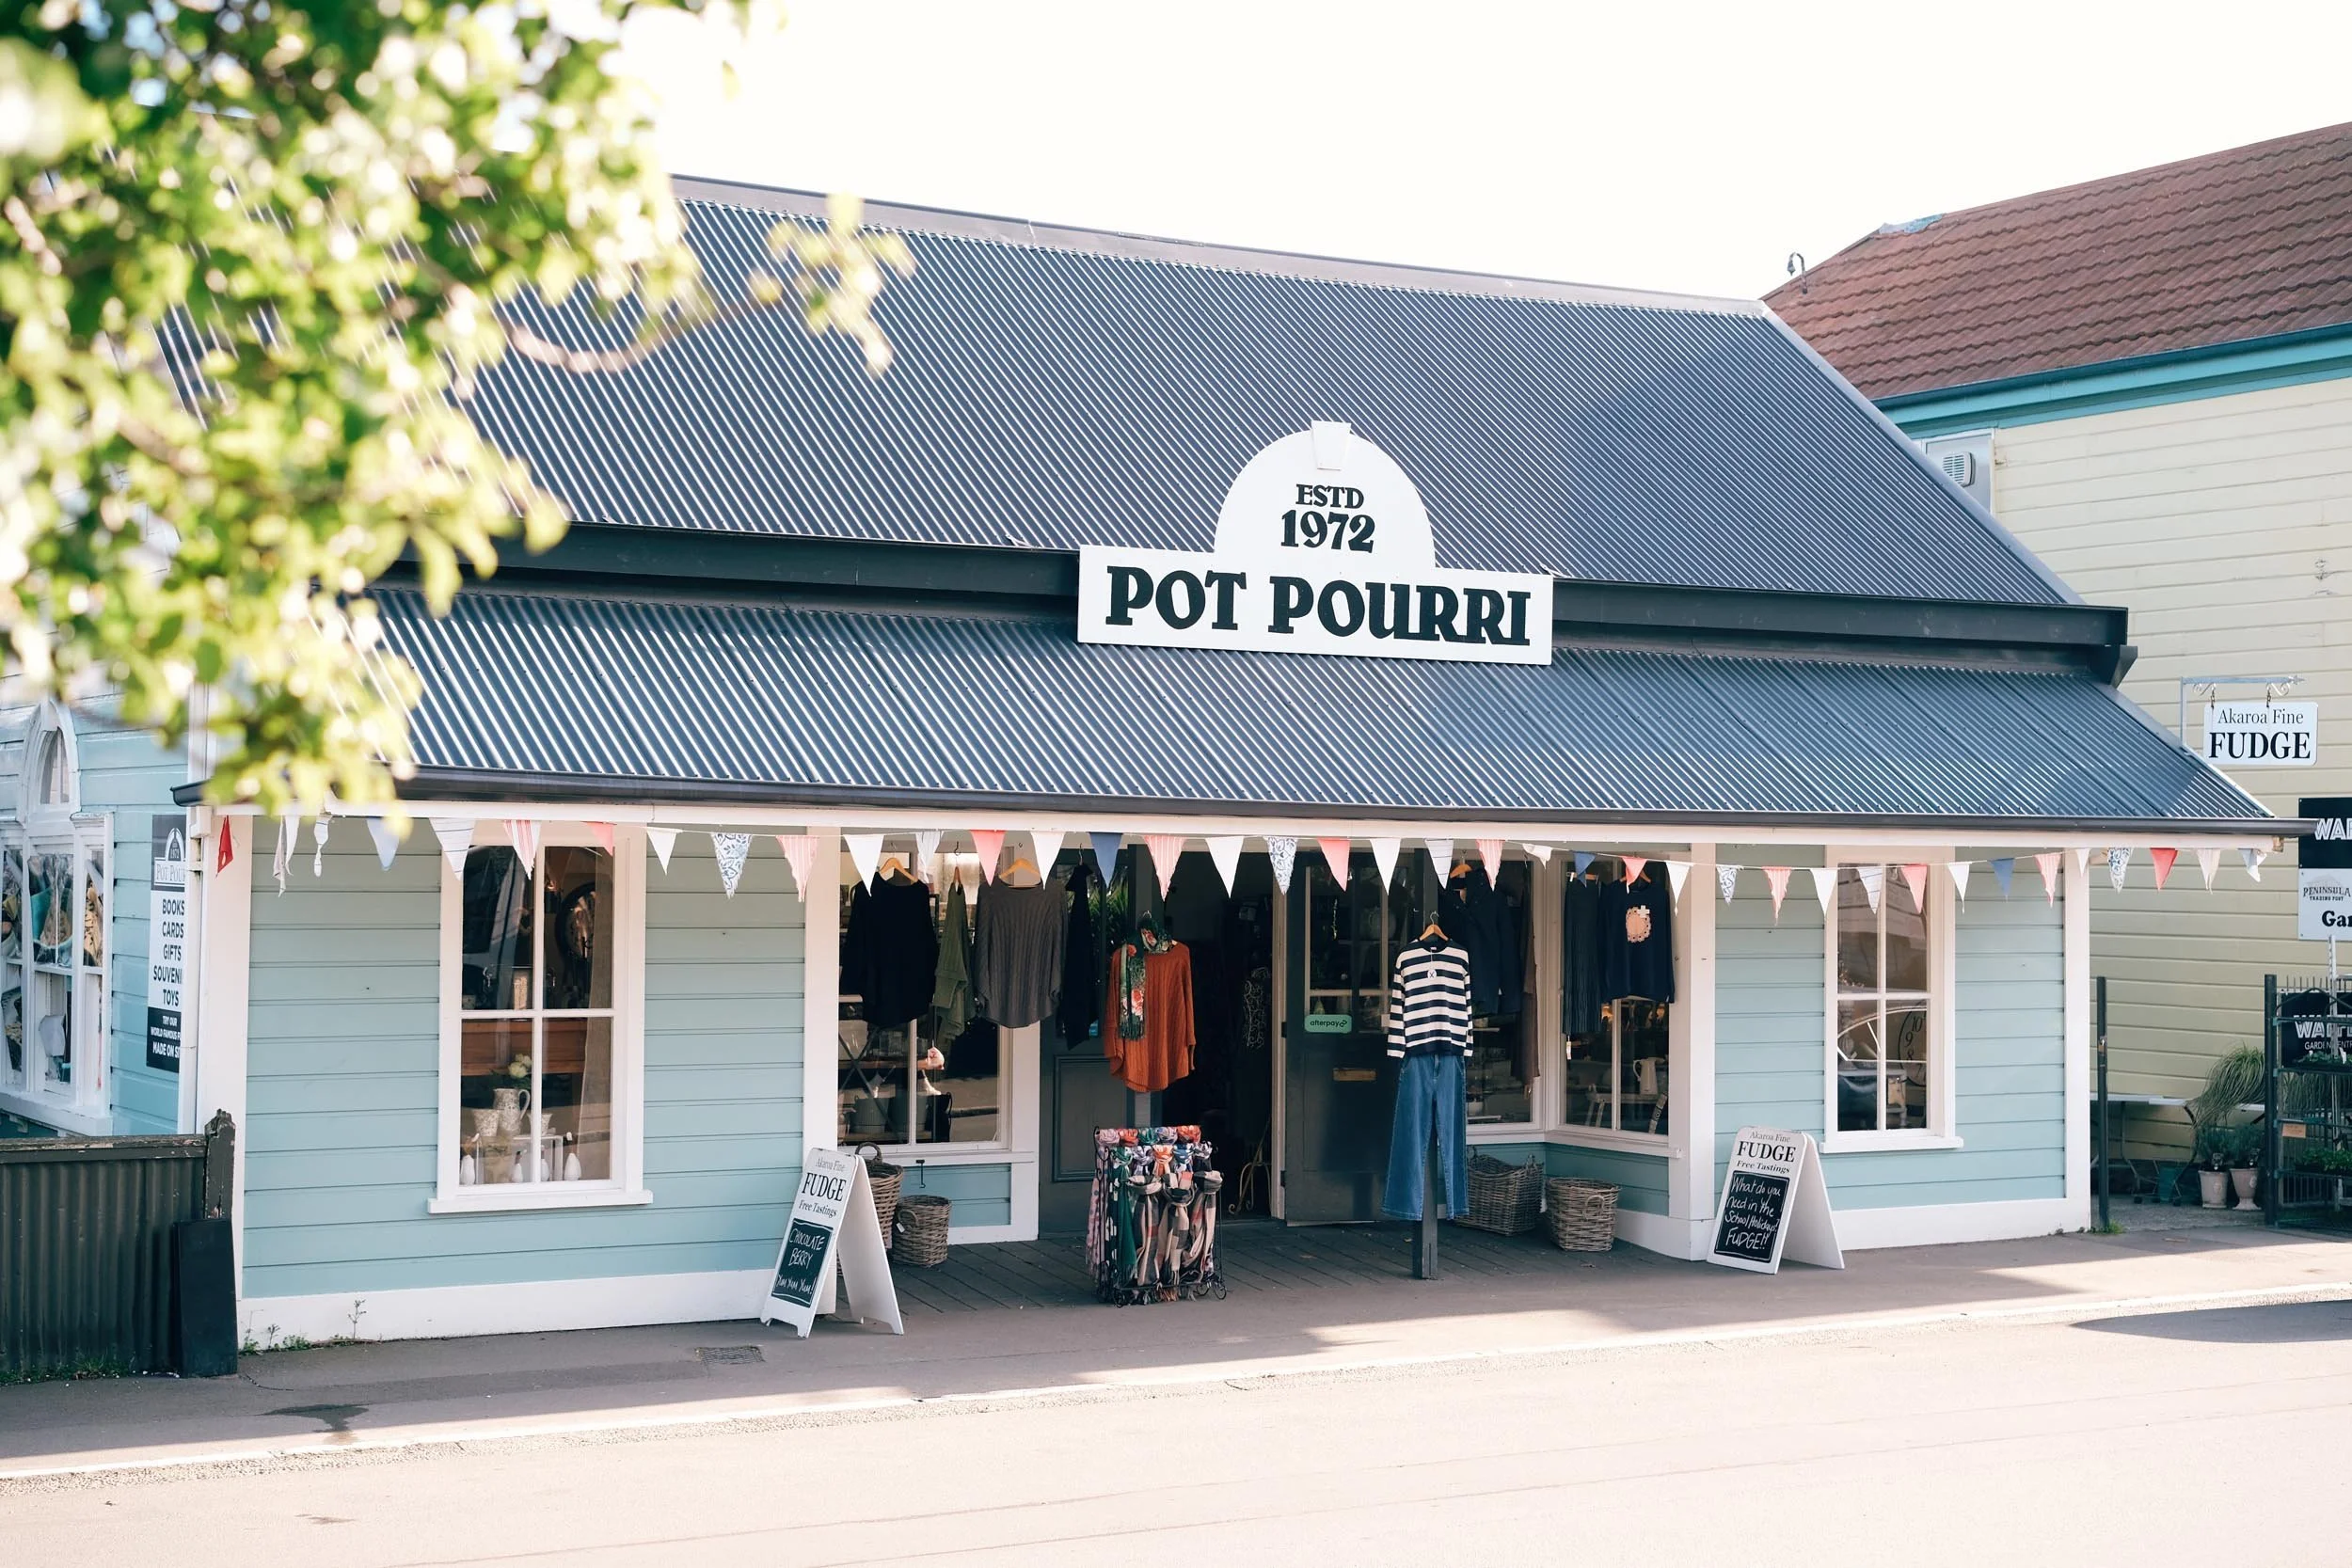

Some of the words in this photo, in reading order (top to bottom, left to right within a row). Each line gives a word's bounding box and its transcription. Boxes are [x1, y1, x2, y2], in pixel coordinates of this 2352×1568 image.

[1295, 483, 1365, 510] ESTD
[1280, 510, 1376, 553] 1972
[1105, 565, 1247, 630] POT
[1267, 576, 1532, 646] POURRI
[2217, 708, 2267, 725] Akaroa
[2272, 708, 2304, 725] Fine
[2208, 731, 2311, 760] FUDGE
[2303, 886, 2352, 898] PENINSULA
[162, 898, 185, 916] BOOKS
[162, 921, 184, 939] CARDS
[163, 943, 182, 961] GIFTS
[163, 989, 179, 1006] TOYS
[1310, 1020, 1340, 1028] afterpay
[152, 1041, 167, 1056] MADE
[167, 1044, 174, 1057] ON
[1750, 1131, 1774, 1142] Akaroa
[1774, 1133, 1791, 1143] Fine
[1737, 1140, 1797, 1163] FUDGE
[1737, 1160, 1755, 1169] Free
[1756, 1162, 1790, 1174] Tastings
[801, 1172, 848, 1202] FUDGE
[1731, 1176, 1756, 1193] What
[1756, 1180, 1766, 1195] do
[1767, 1186, 1781, 1204] you
[798, 1199, 813, 1212] Free
[812, 1202, 837, 1219] Tastings
[1748, 1198, 1758, 1212] in
[1724, 1210, 1750, 1227] School
[788, 1227, 826, 1251] CHOCOLATE
[787, 1247, 814, 1270] BERRY
